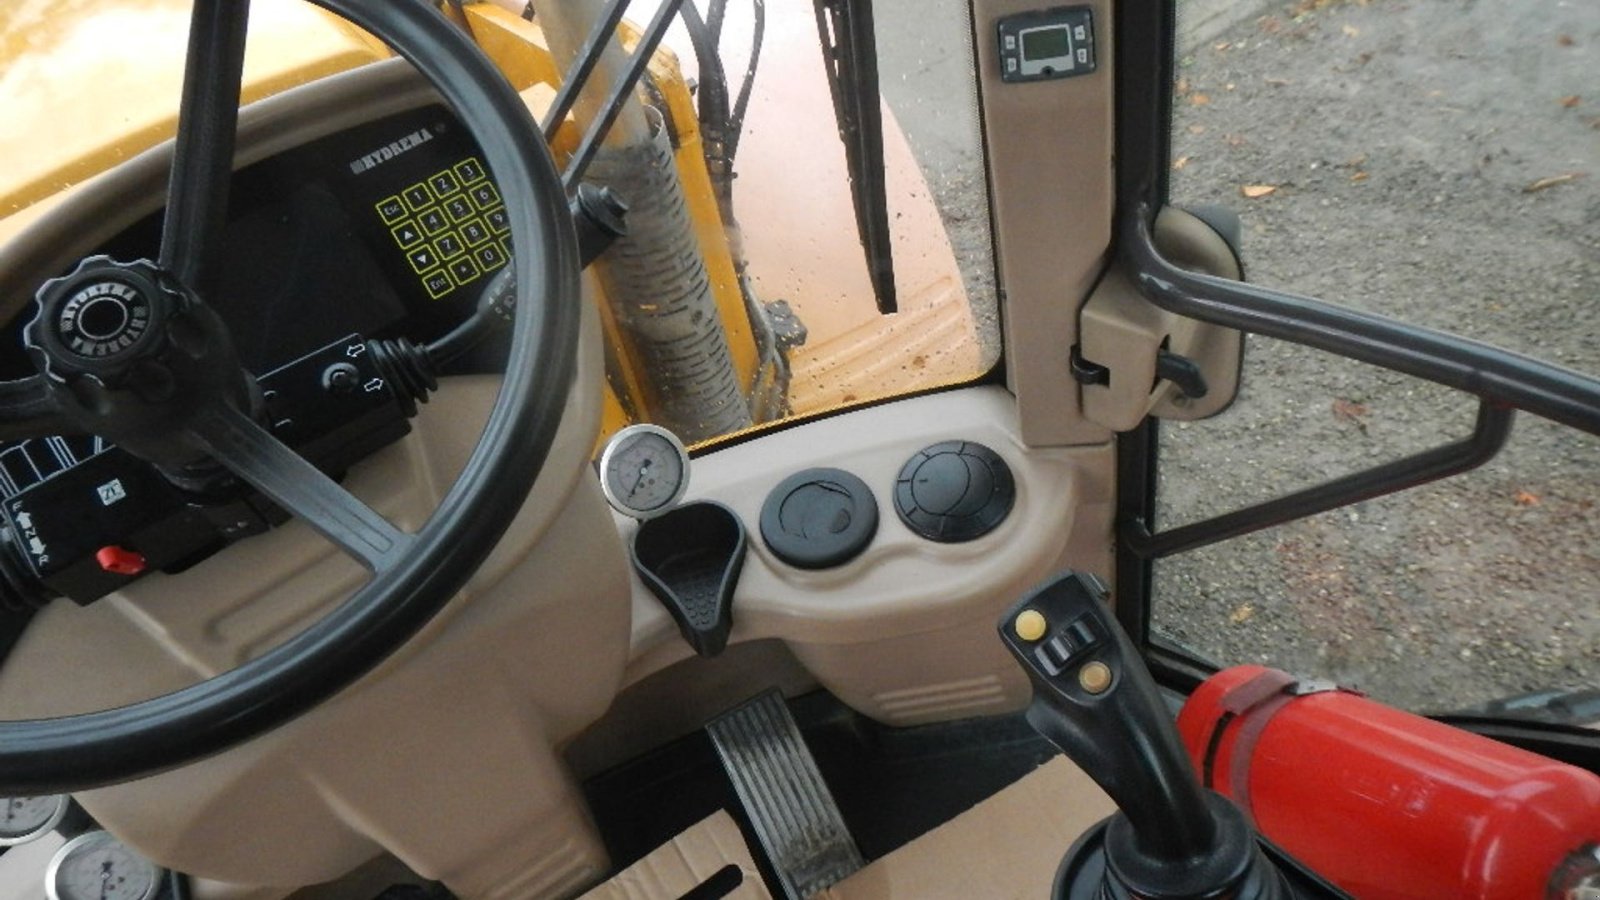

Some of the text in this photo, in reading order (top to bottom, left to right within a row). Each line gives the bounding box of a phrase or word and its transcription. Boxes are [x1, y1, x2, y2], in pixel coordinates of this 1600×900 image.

[361, 127, 434, 170] HYDREMA
[383, 204, 400, 216] Esc
[430, 278, 446, 290] Ent
[61, 282, 137, 319] HYDREMA
